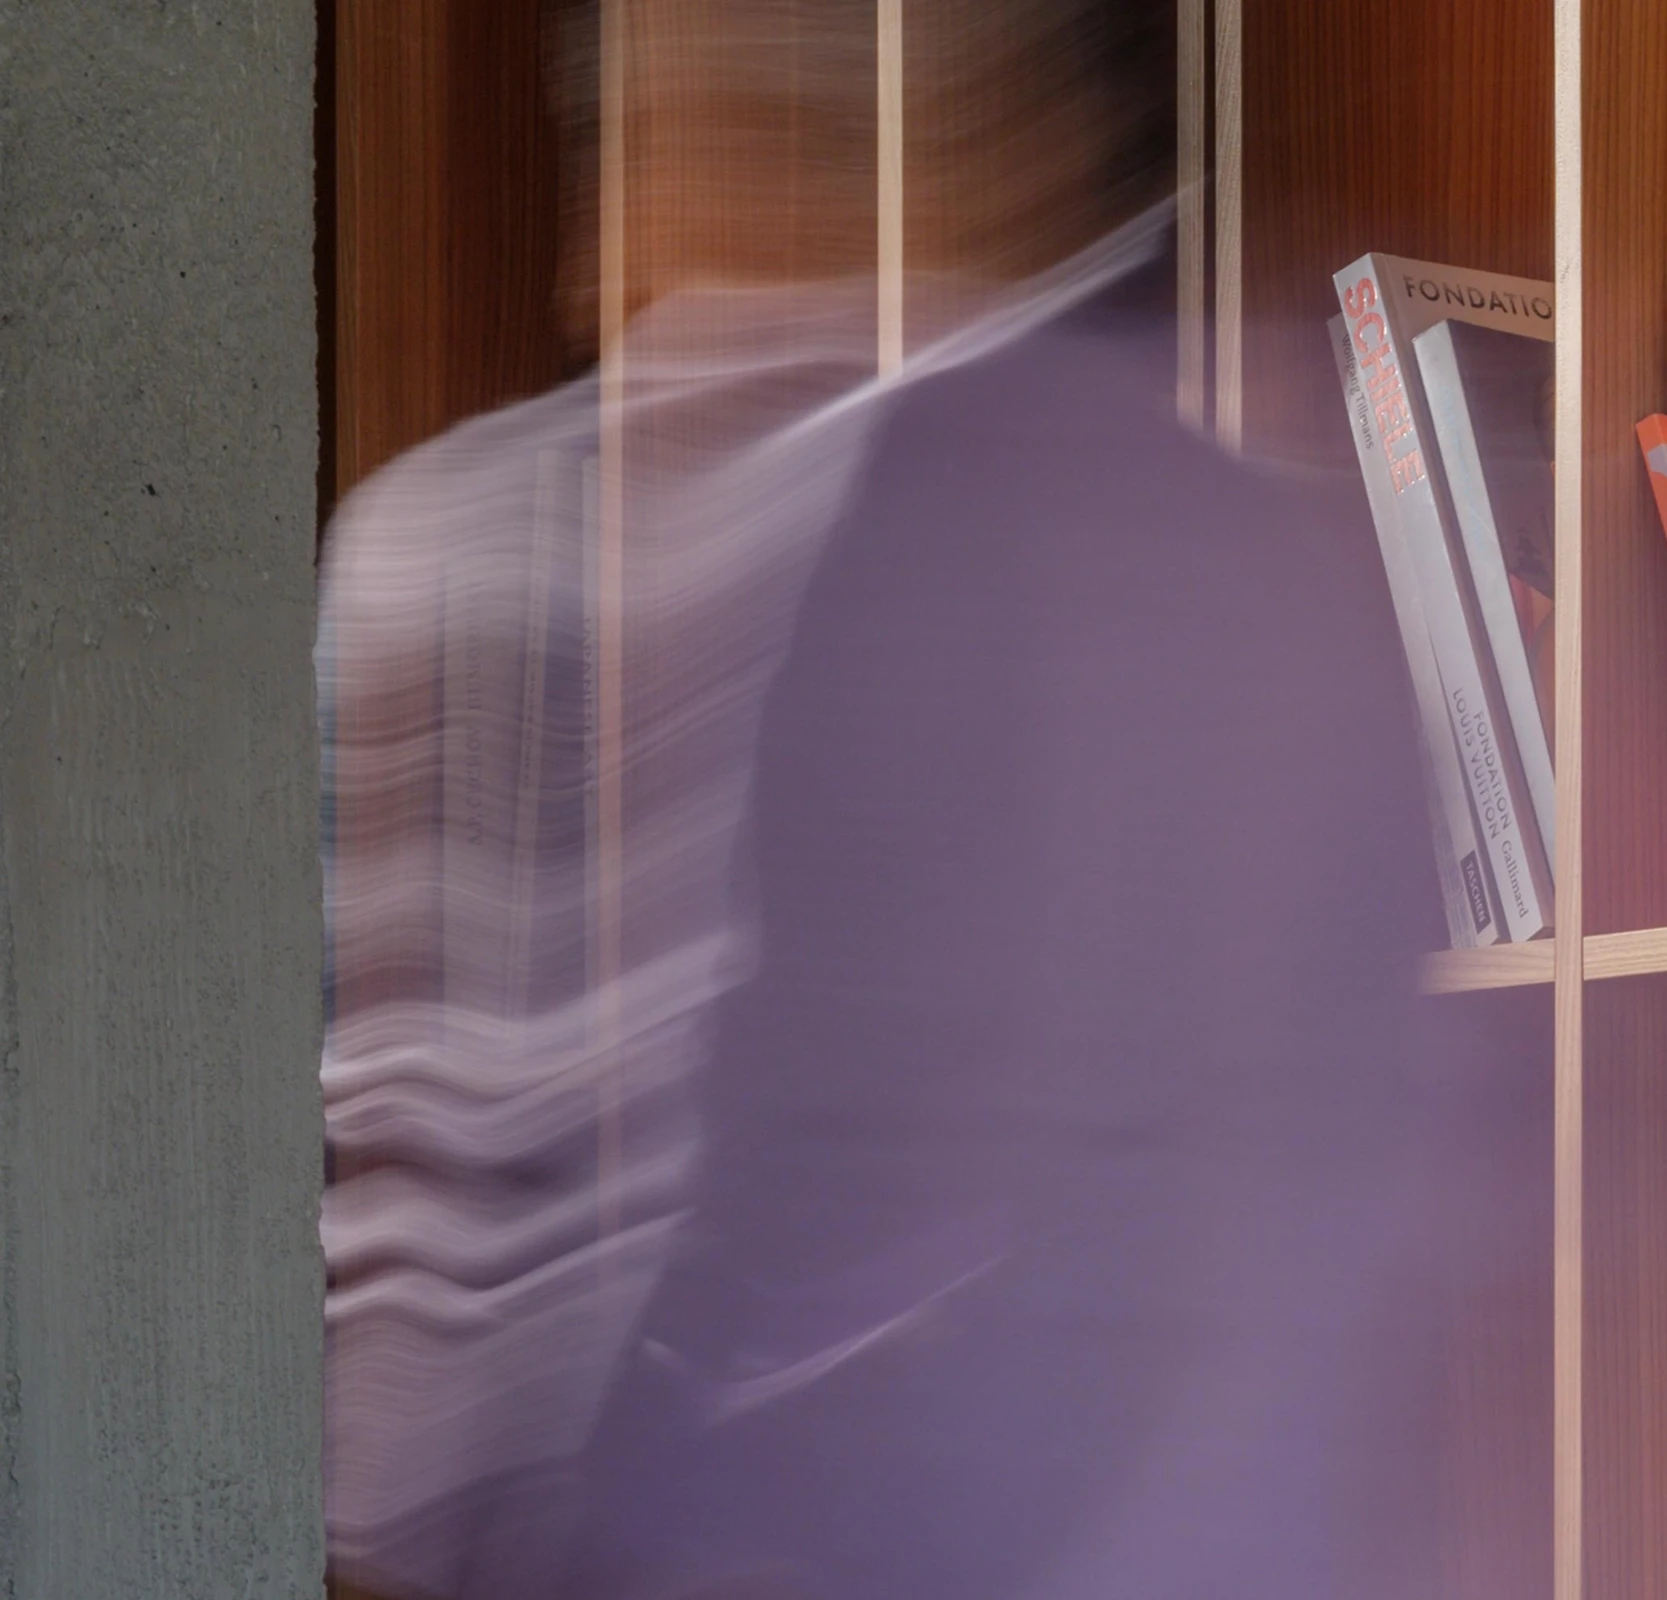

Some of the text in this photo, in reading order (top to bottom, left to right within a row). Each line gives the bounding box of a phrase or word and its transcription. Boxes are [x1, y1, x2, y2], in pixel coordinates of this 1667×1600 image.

[1340, 333, 1376, 451] Wolfgang Tillmans
[1344, 277, 1426, 496] SCHIELE
[1453, 687, 1500, 840] LOUIS VUITTON
[1474, 710, 1513, 831] FONDATION
[1465, 857, 1488, 924] TASCHEN
[1501, 839, 1529, 920] Gallimard
